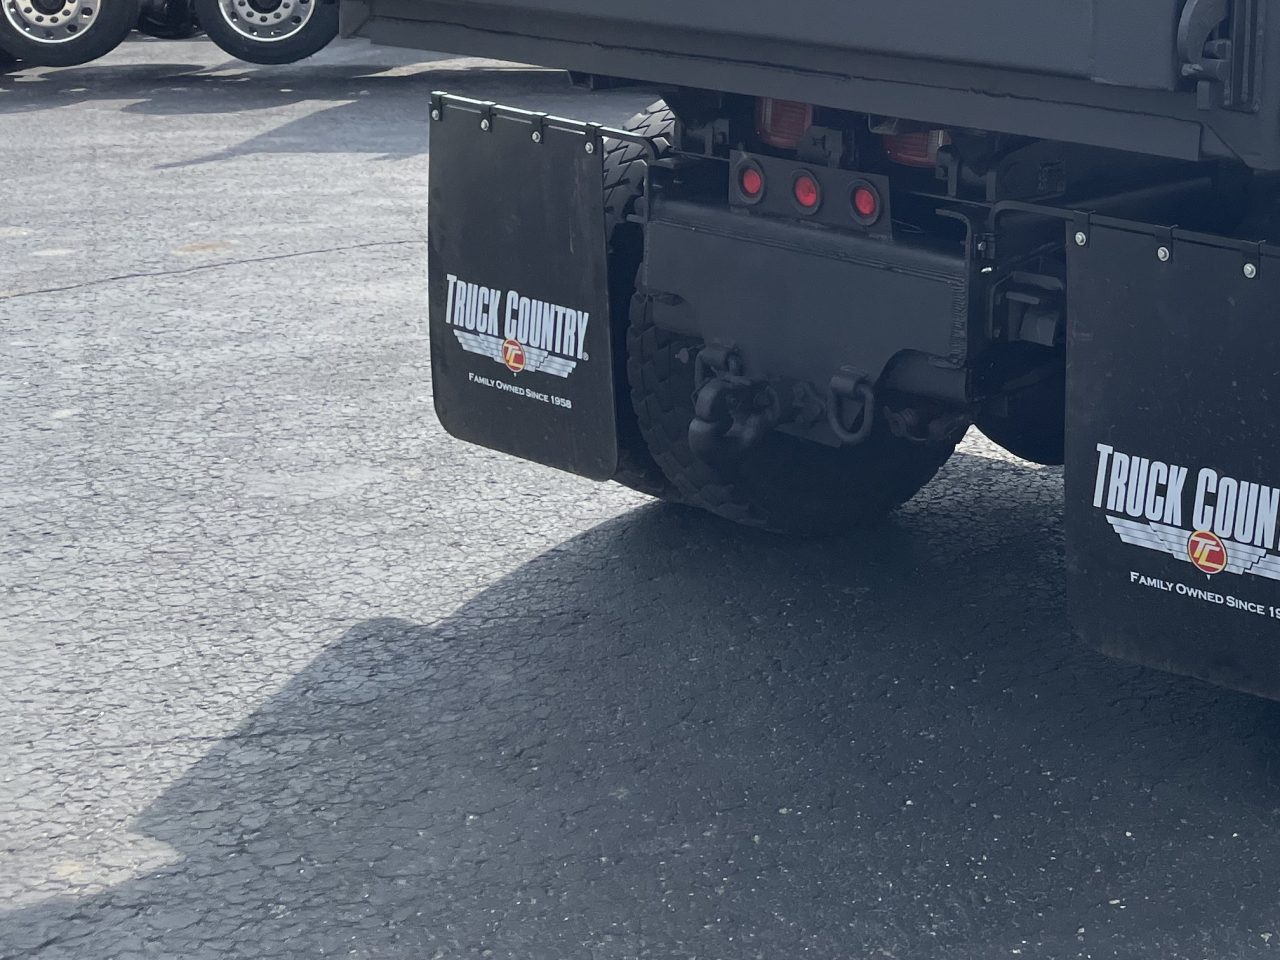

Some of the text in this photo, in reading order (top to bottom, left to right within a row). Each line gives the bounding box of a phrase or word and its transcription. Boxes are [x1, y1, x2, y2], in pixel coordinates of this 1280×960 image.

[446, 273, 589, 360] TRUCK COUNTRY
[468, 372, 572, 409] FAMILY OWNED SINCE 1958
[1093, 442, 1188, 527] TRUCK
[1130, 571, 1174, 592] FAMILY
[1175, 583, 1224, 605] OWNED
[1226, 595, 1265, 615] SINCE
